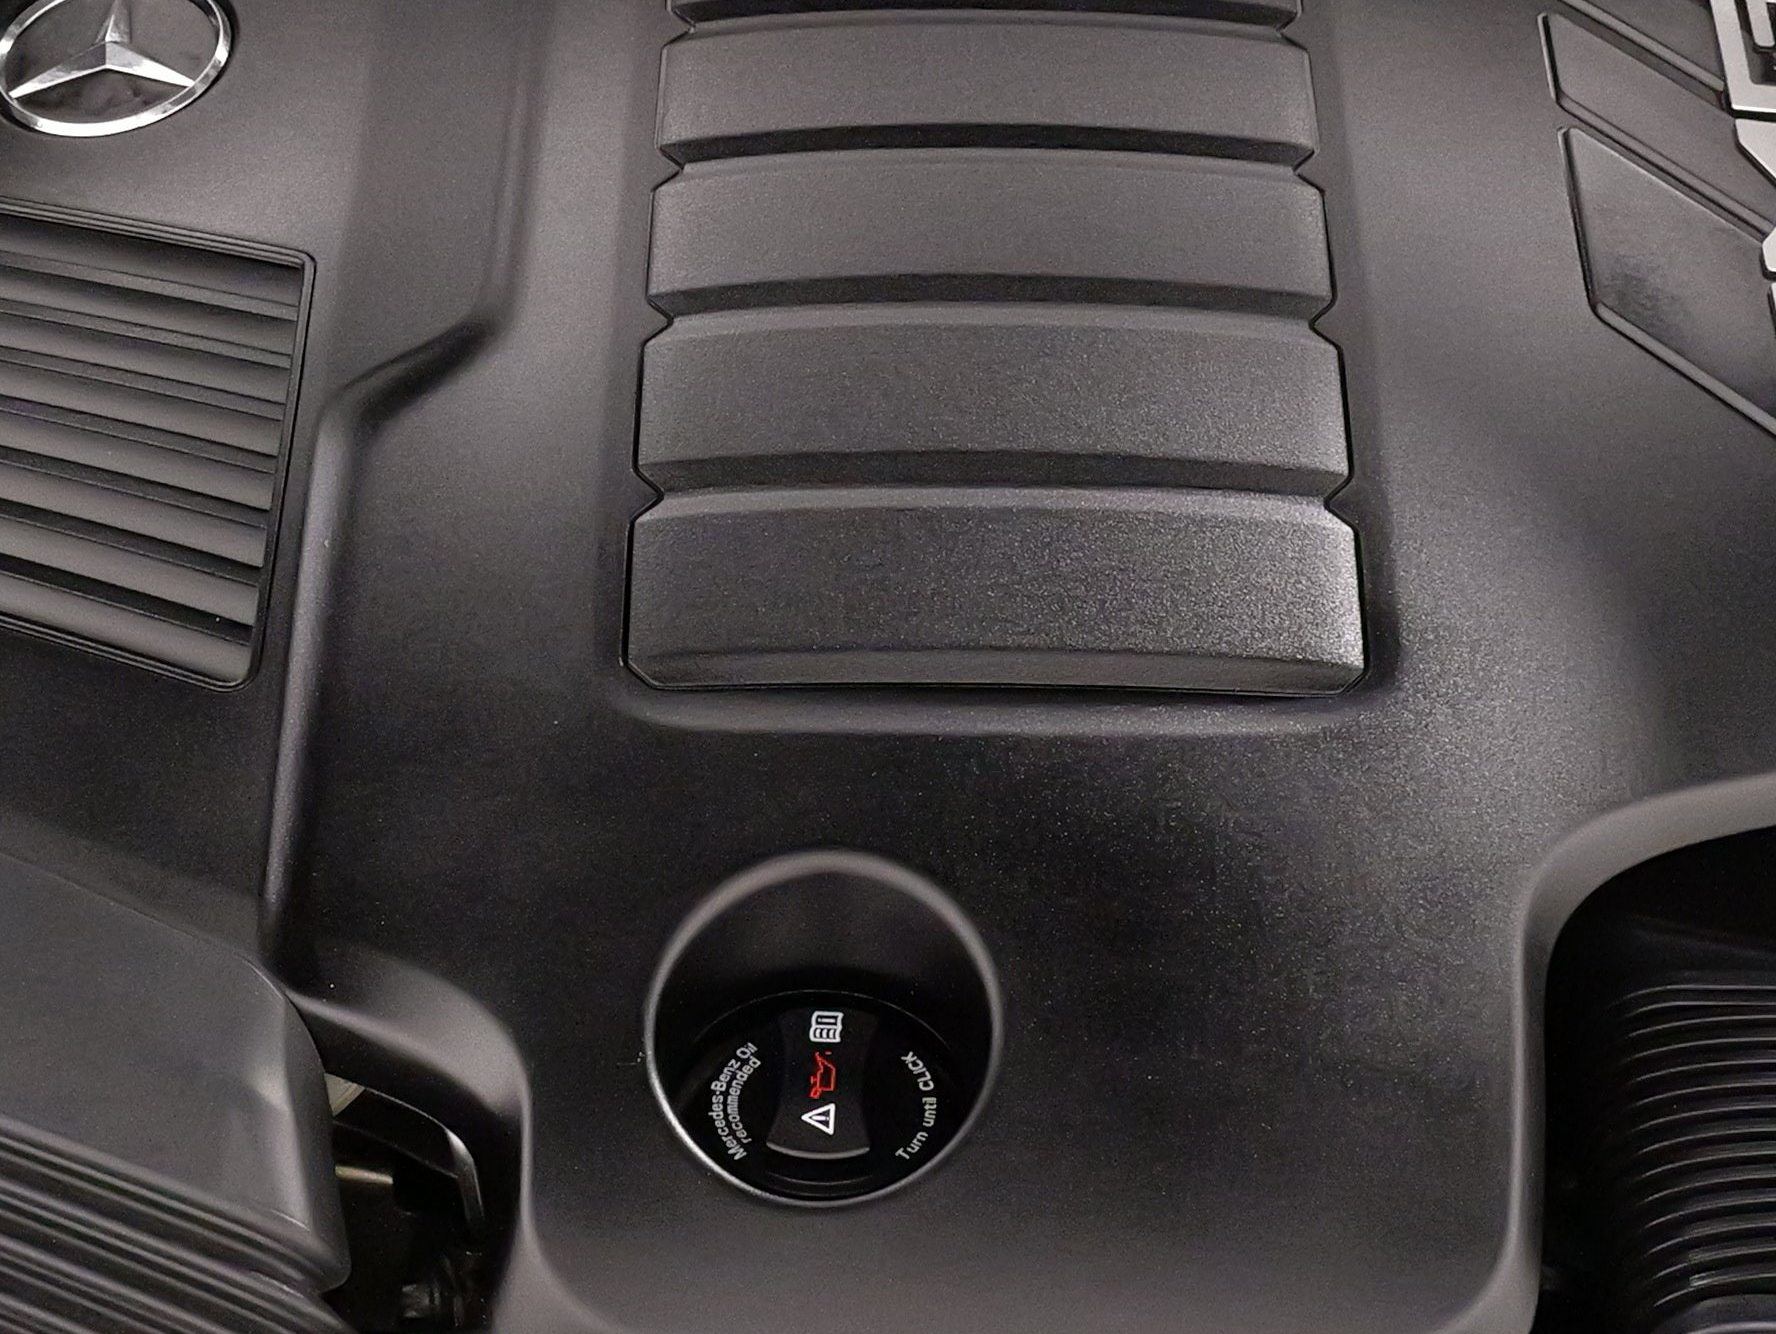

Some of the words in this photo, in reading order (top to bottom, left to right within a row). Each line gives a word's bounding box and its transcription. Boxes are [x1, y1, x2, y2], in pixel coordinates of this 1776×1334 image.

[900, 1051, 934, 1092] CLICK
[708, 1057, 748, 1161] Mercedes-Benz
[737, 1041, 759, 1060] Oil
[726, 1056, 763, 1147] recommended
[922, 1097, 936, 1128] until
[894, 1131, 929, 1161] Turn
